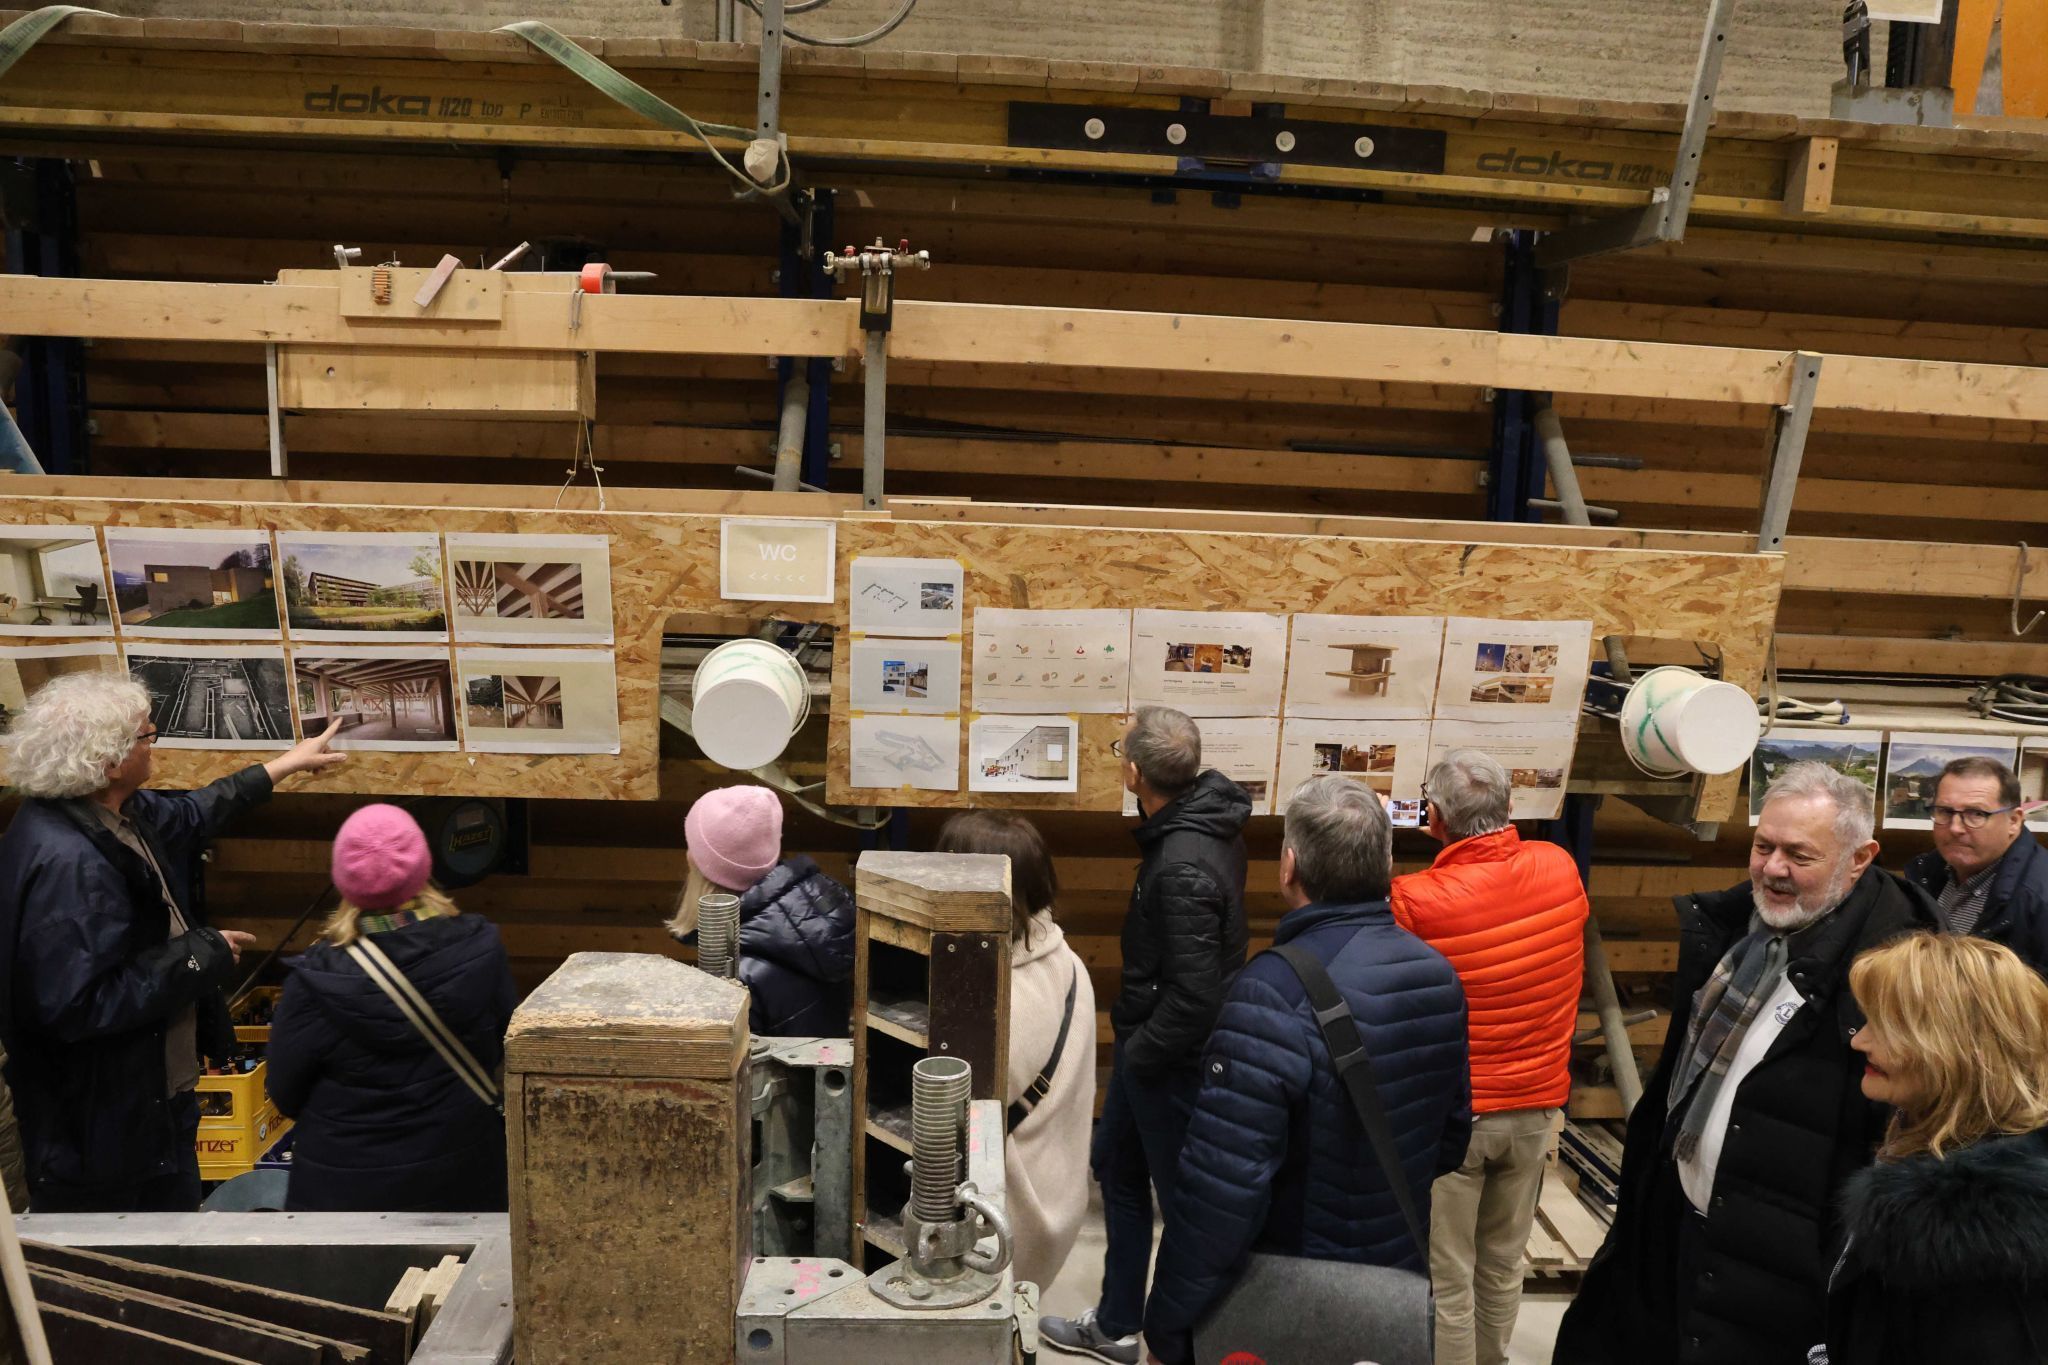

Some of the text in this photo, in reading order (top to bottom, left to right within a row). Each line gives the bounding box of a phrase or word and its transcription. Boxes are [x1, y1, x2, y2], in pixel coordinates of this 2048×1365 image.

[304, 84, 432, 116] doka
[438, 96, 473, 117] H20
[481, 100, 503, 118] top
[519, 102, 532, 120] P
[1476, 147, 1614, 181] doka
[1617, 163, 1654, 184] H20
[758, 543, 797, 561] WC
